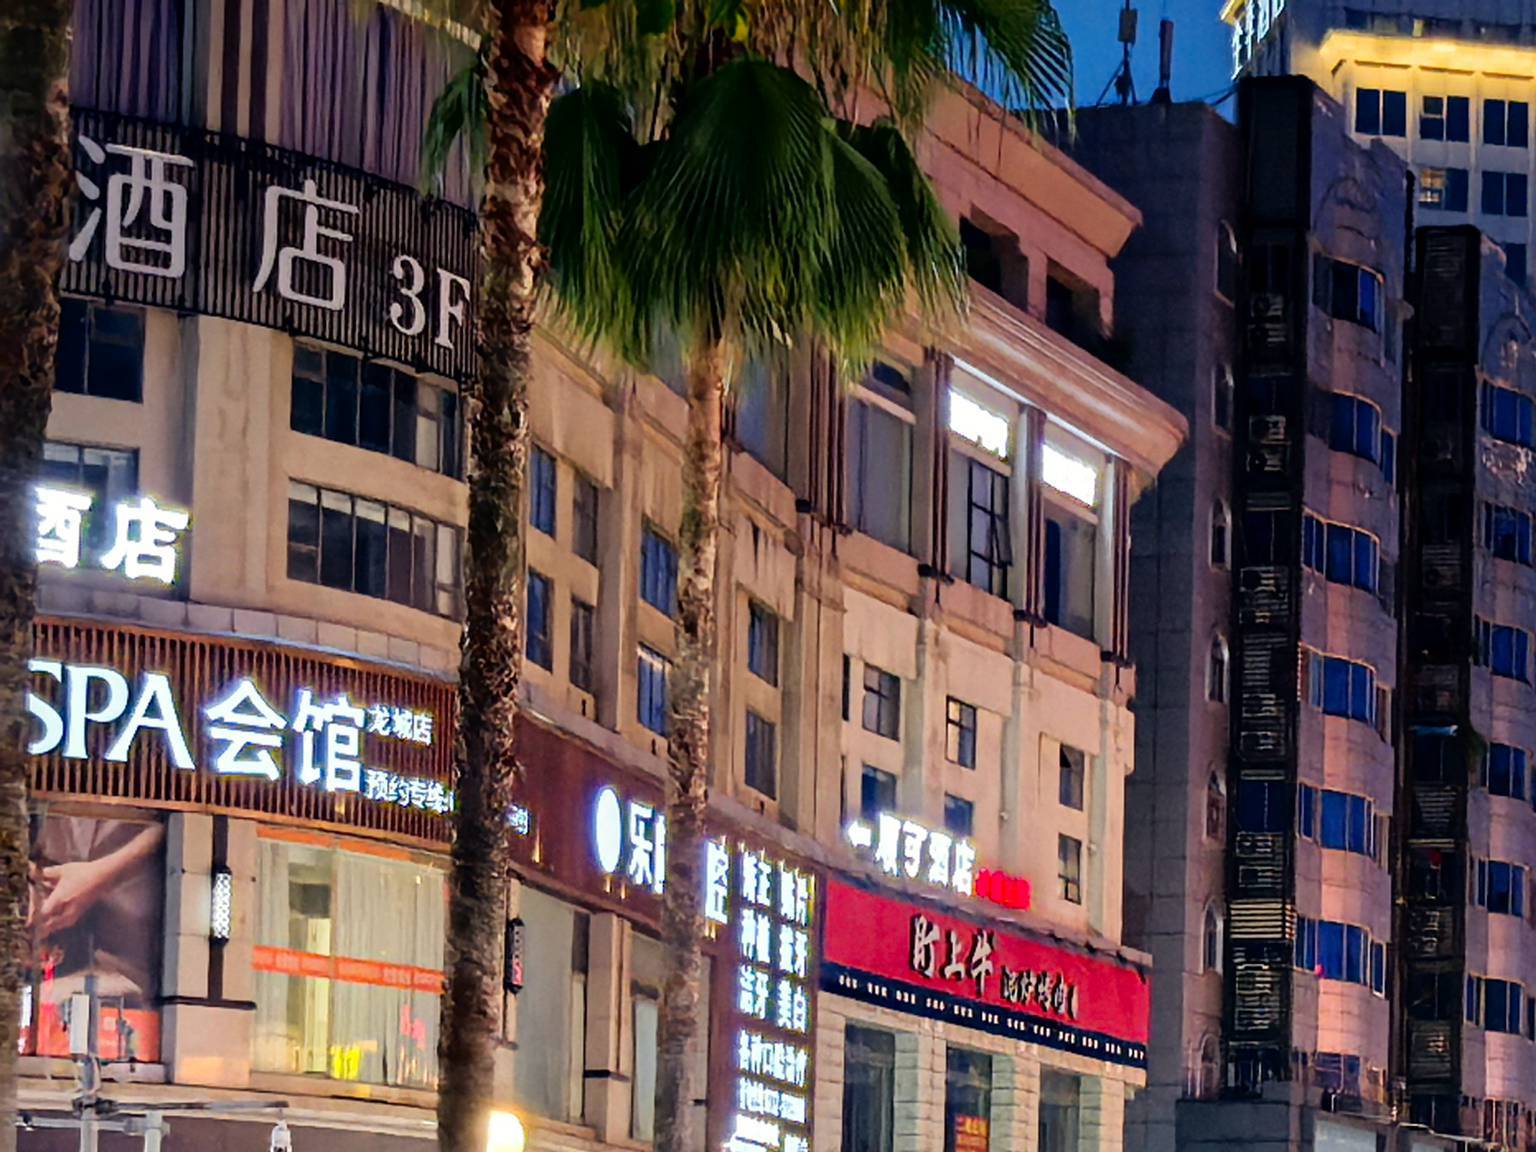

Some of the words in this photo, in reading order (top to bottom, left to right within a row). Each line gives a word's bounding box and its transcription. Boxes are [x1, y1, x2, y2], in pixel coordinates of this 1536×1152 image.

[68, 134, 360, 312] 酒店
[388, 254, 471, 350] 3F
[204, 677, 366, 794] 会馆
